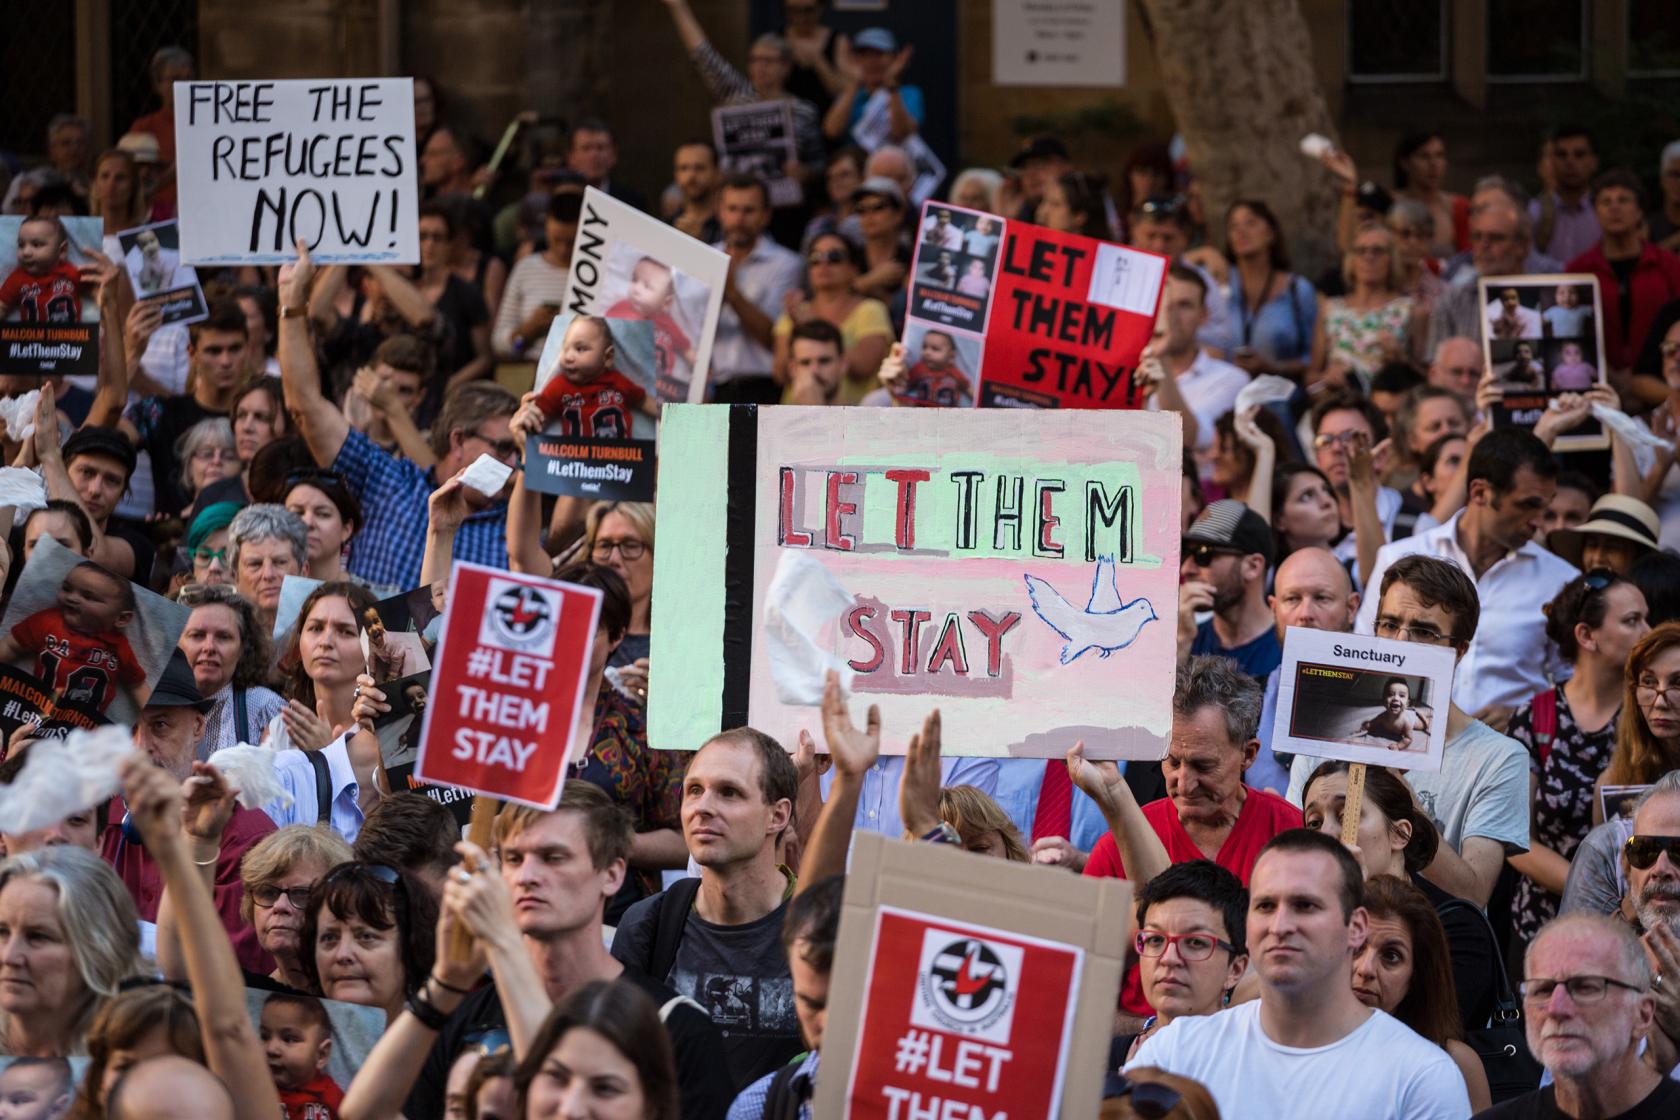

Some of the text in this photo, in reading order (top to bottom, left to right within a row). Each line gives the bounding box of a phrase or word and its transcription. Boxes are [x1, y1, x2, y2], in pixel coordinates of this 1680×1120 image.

[189, 83, 382, 125] FREE THE
[212, 131, 404, 181] REFUGEES
[250, 186, 398, 253] NOW!
[1003, 235, 1085, 287] LET
[1012, 289, 1116, 350] THEM
[9, 342, 82, 361] #LetThemStay
[1023, 348, 1138, 405] STAY!
[538, 442, 643, 462] MALCOLM TURNBULL
[547, 460, 633, 483] #LetThemStay
[778, 465, 1134, 564] LET THEM
[846, 606, 1022, 677] STAY
[1333, 644, 1406, 667] Sanctuary
[467, 647, 555, 690] #LET
[51, 708, 101, 733] TURNBU
[457, 684, 549, 733] THEM
[452, 727, 538, 773] STAY
[895, 1029, 1013, 1093] #LET
